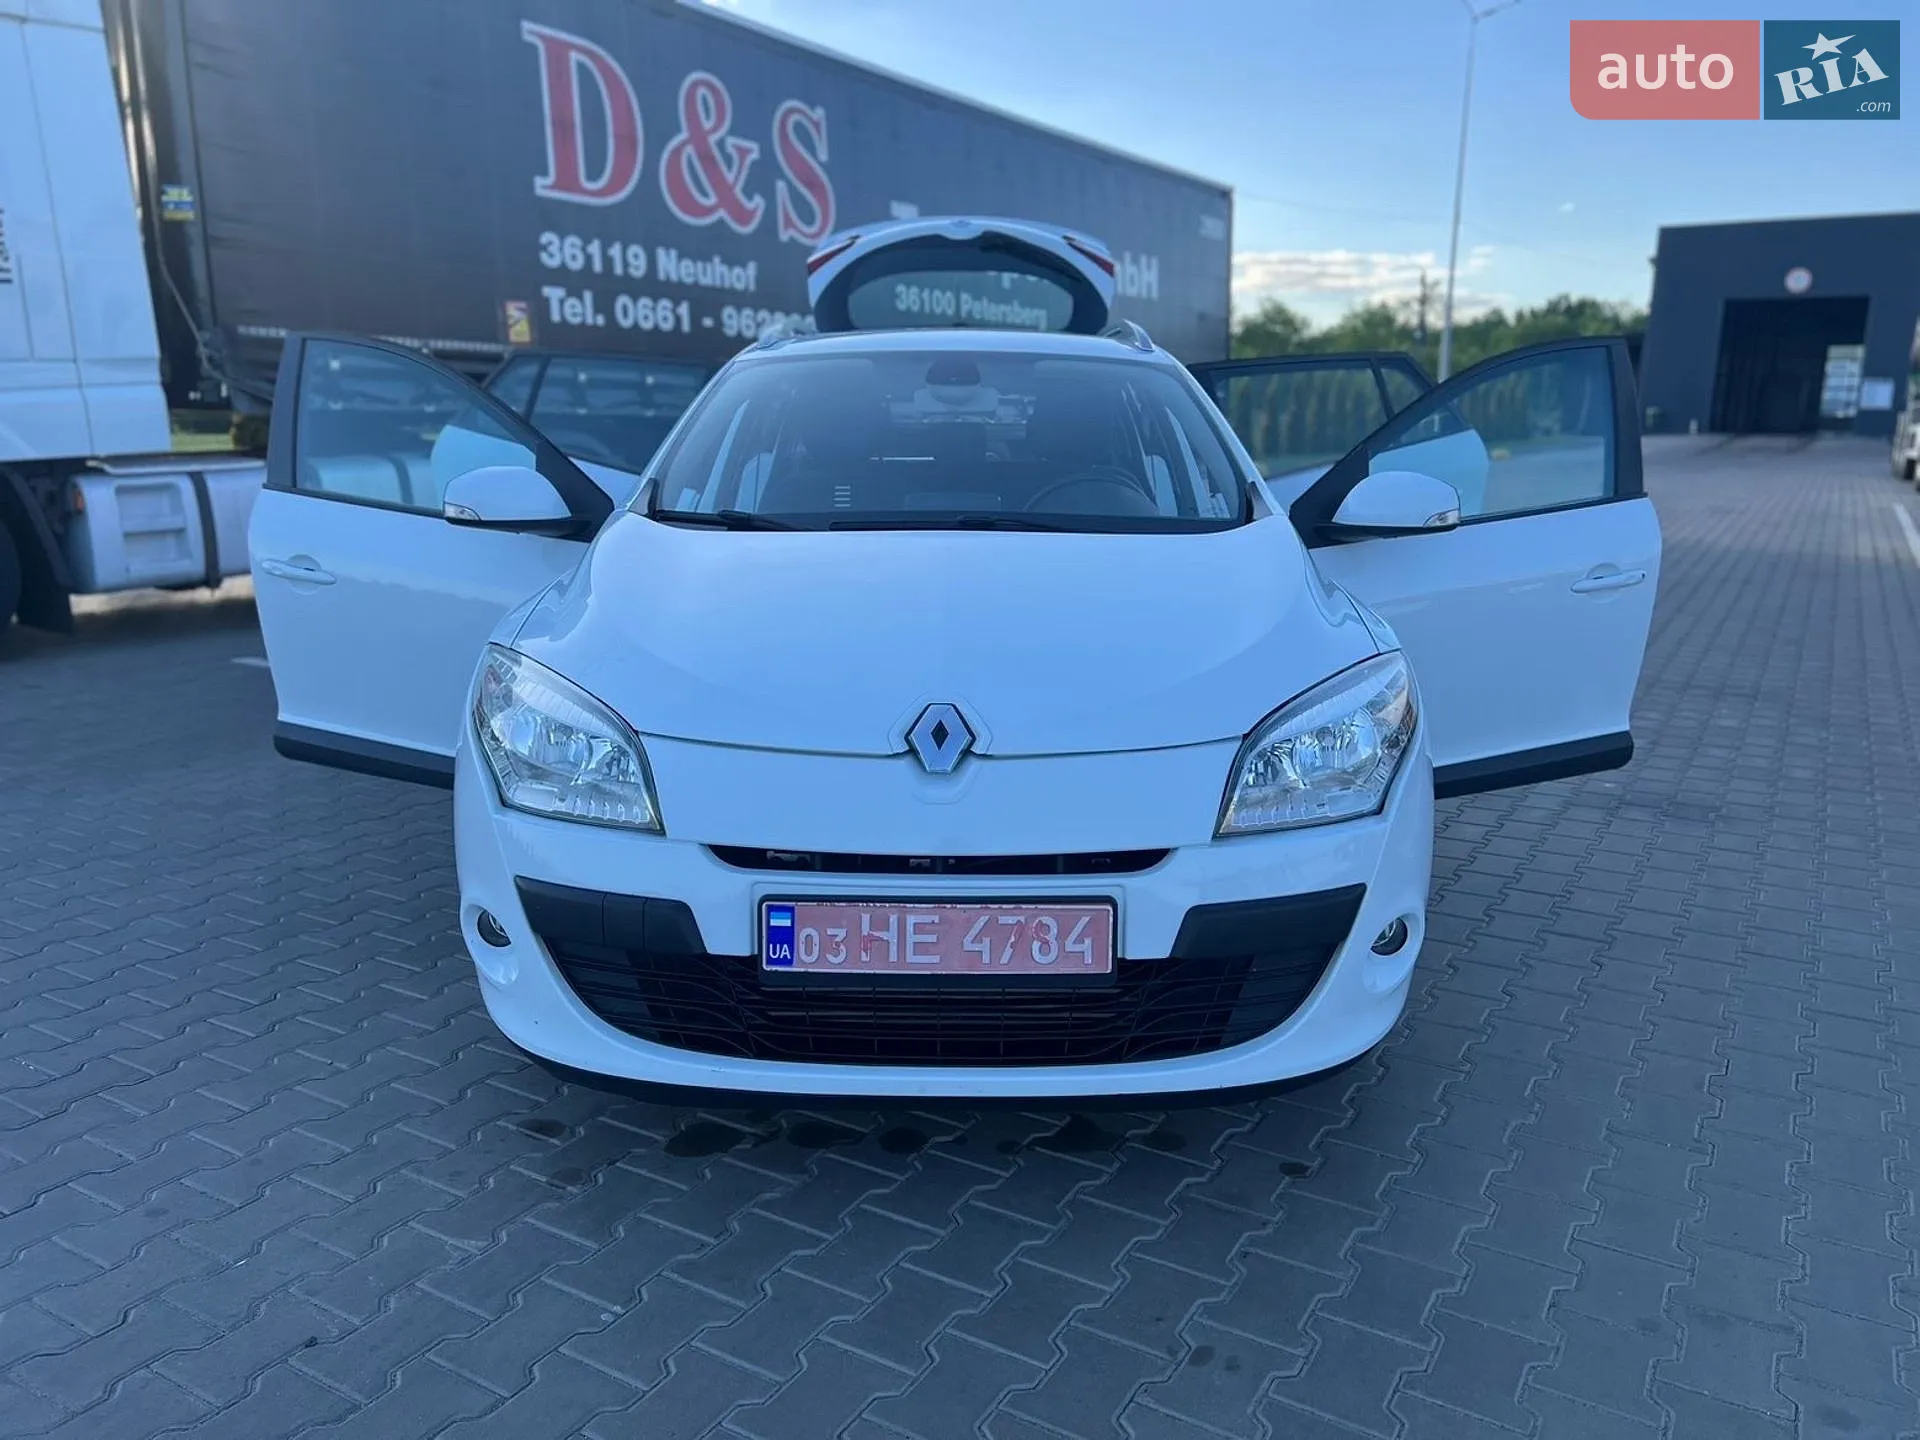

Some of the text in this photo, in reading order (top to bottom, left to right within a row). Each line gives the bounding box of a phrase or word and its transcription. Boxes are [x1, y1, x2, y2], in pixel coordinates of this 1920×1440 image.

[520, 19, 837, 247] D&S
[538, 231, 758, 292] 36119 Neuhof
[541, 285, 606, 328] Tel.
[614, 294, 691, 334] 0661
[894, 282, 957, 317] 36100
[769, 943, 791, 960] UA
[799, 912, 1093, 967] 03 HE 4784
